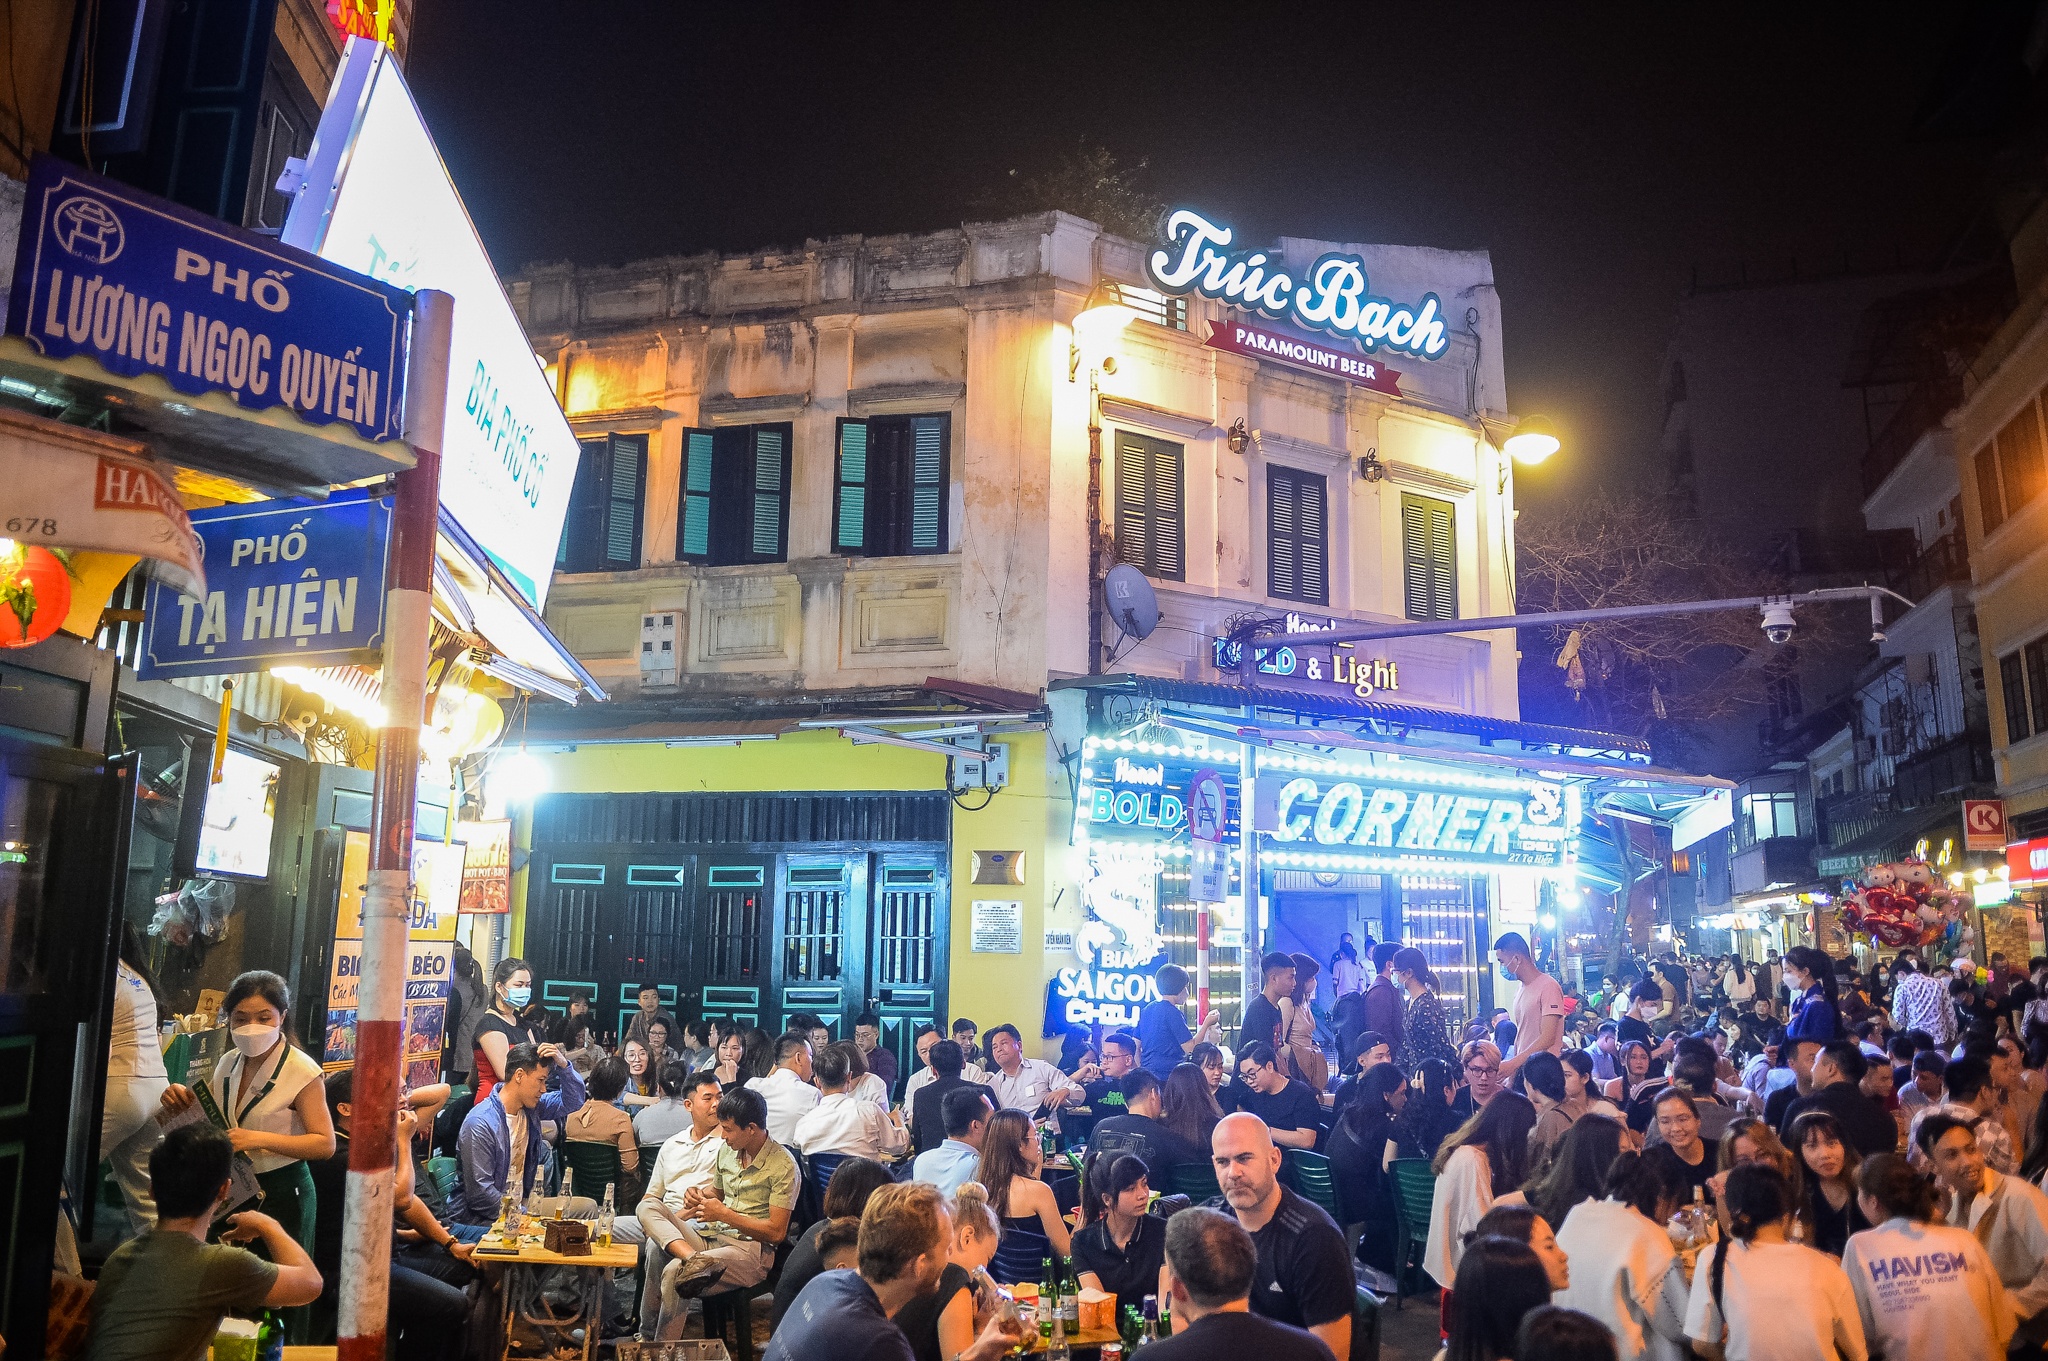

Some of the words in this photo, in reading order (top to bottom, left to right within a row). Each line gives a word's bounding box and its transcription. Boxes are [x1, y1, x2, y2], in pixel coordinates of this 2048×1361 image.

[174, 248, 294, 312] PHỐ
[1151, 209, 1292, 311] Trúc
[1295, 258, 1447, 355] Bạch
[44, 268, 171, 367] LƯƠNG
[178, 311, 272, 401] NGỌC
[280, 346, 379, 428] QUYẾN
[1236, 328, 1338, 369] PARAMOUNT
[1340, 356, 1376, 381] BEER
[466, 359, 498, 441] BIA
[5, 517, 58, 537] 678
[231, 518, 311, 567] PHỐ
[178, 591, 227, 654] TẠ
[242, 567, 358, 647] HIỆN
[1307, 658, 1322, 680] &
[1333, 655, 1399, 698] Light
[1090, 787, 1183, 828] BOLD
[1273, 777, 1523, 855] CORNER
[1508, 852, 1521, 863] 27
[412, 951, 446, 976] BÉO
[1057, 966, 1163, 1003] SAIGON
[333, 983, 347, 1000] Các
[407, 983, 440, 998] BBQ
[1869, 1252, 1968, 1282] HAVISM
[1876, 1282, 1895, 1291] HAVE
[1938, 1275, 1958, 1283] WANT
